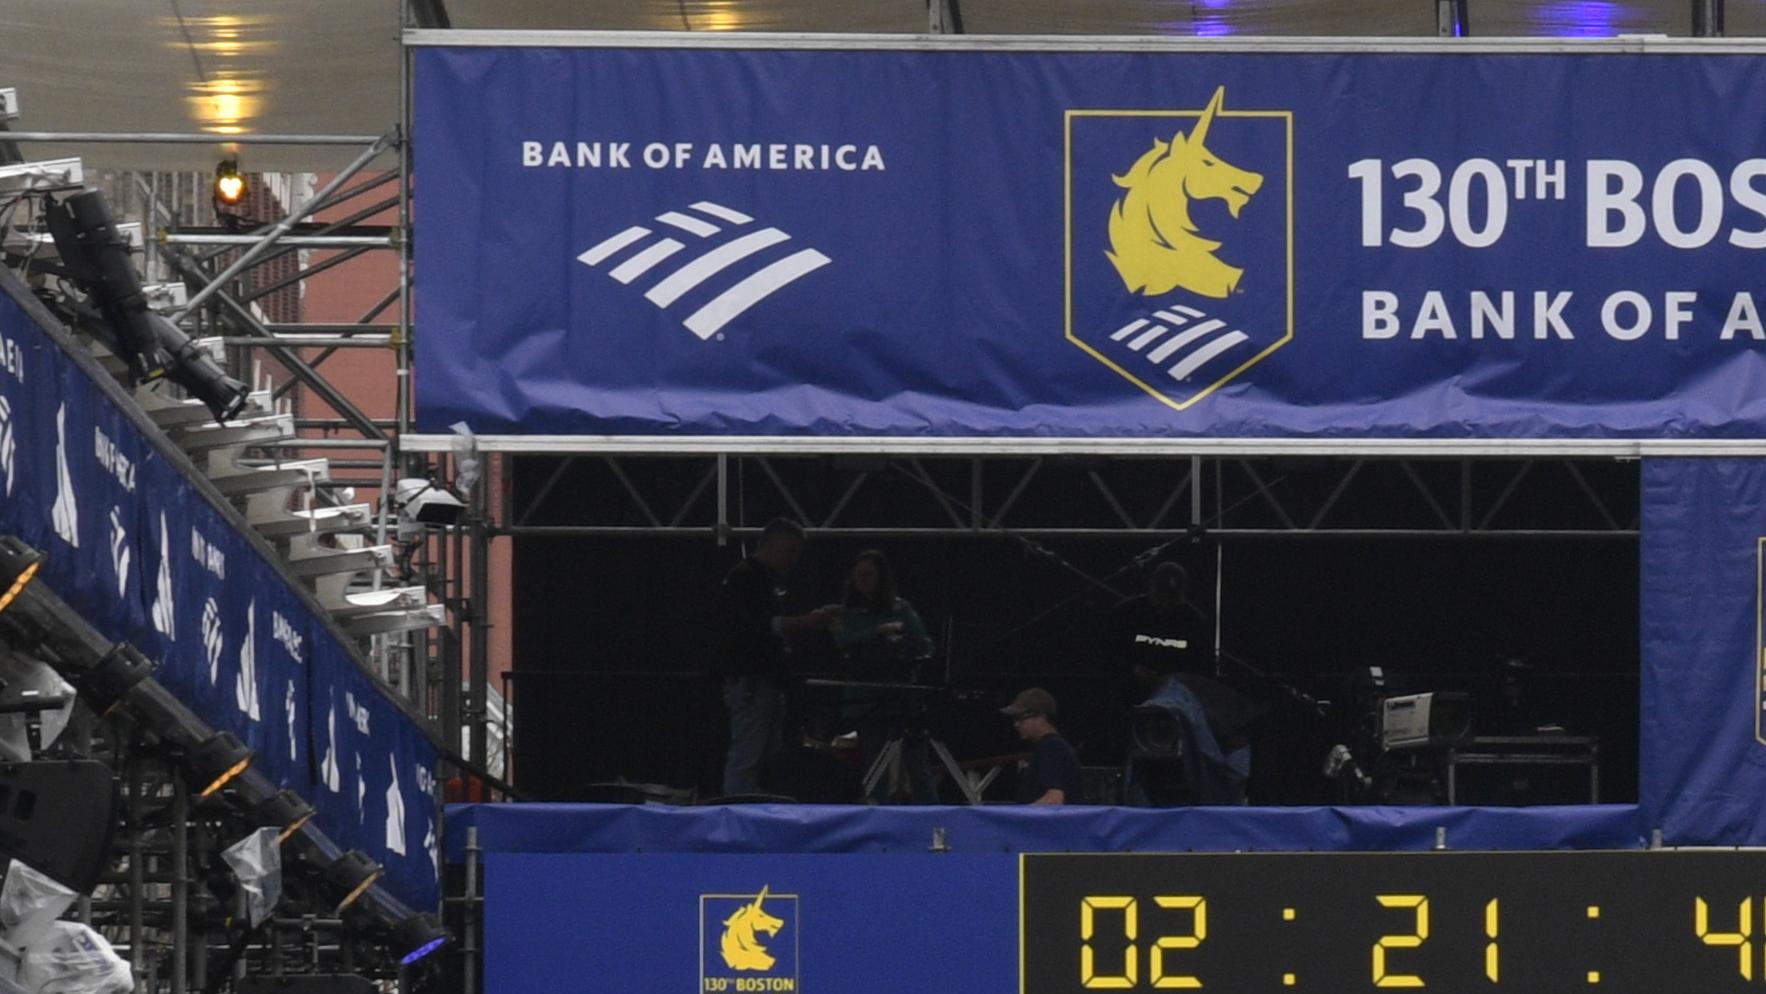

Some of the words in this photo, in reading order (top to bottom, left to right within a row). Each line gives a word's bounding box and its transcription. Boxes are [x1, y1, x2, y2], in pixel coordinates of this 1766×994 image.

[523, 141, 631, 168] BANK
[643, 142, 693, 169] OF
[703, 143, 886, 171] AMERICA
[1362, 290, 1574, 340] BANK
[1601, 290, 1698, 340] OF
[1081, 896, 1206, 988] 02
[1372, 895, 1498, 987] 21
[735, 977, 794, 991] BOSTON
